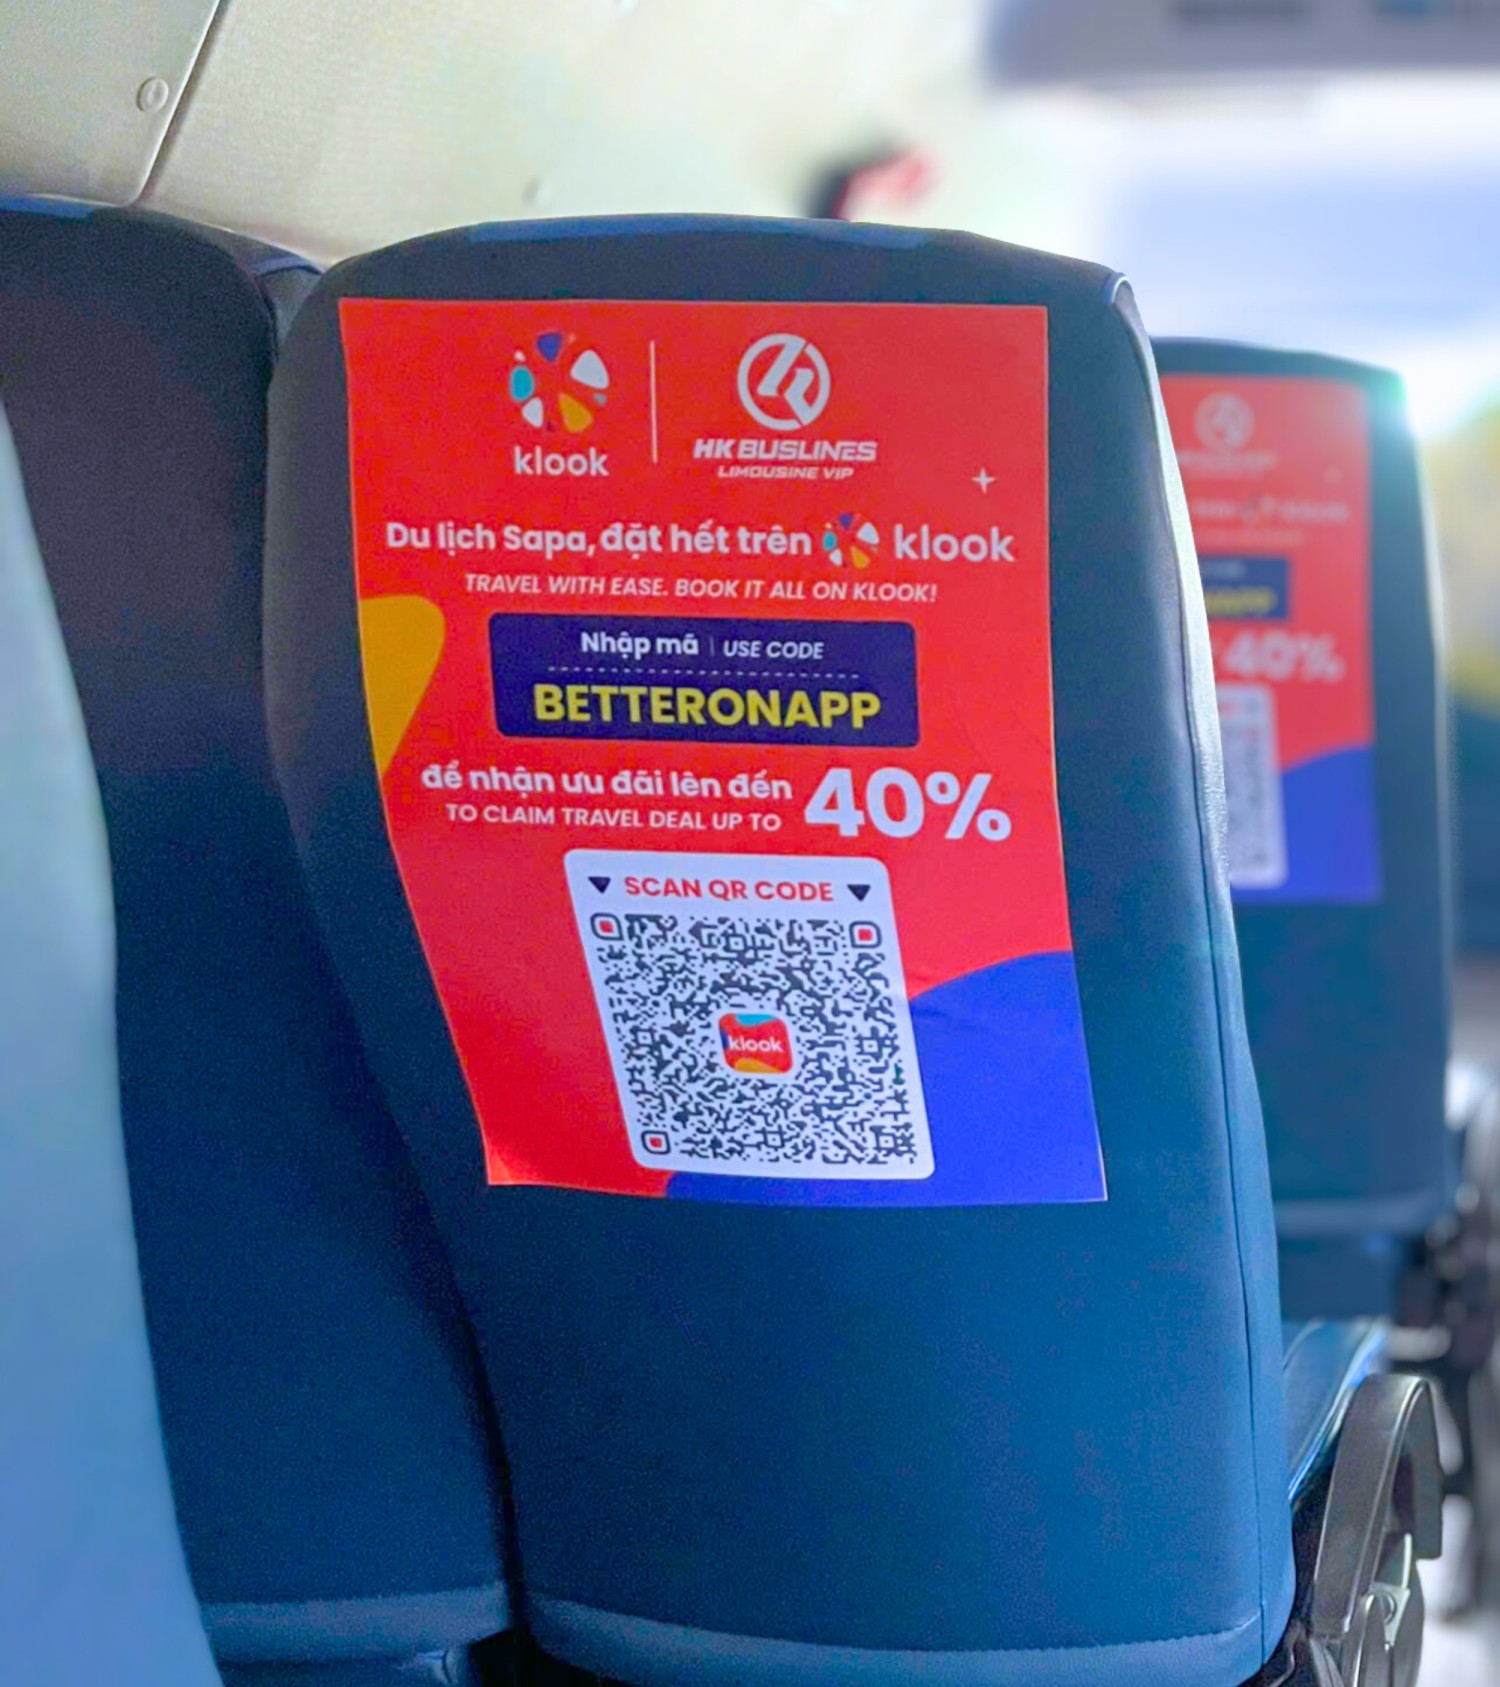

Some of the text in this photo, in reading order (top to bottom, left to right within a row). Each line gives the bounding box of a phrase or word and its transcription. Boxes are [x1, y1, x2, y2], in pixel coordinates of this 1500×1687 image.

[513, 445, 609, 477] klook
[693, 438, 877, 462] HK BUSLINES
[717, 465, 854, 480] LIMOUSINE VIP
[386, 519, 1015, 562] Du lịch Sapa, đặt hết trên klook
[465, 573, 938, 602] TRAVEL WITH EASE. BOOK IT ALL ON KLOOK!
[580, 631, 825, 660] Nhập mã USE CODE
[533, 683, 882, 729] BETTERONAPP
[421, 760, 1012, 842] để nhận ưu đãi lên đến 40%
[446, 804, 782, 831] TO CLAIM TRAVEL DEAL UP TO
[624, 877, 834, 902] SCAN QR CODE
[728, 1034, 784, 1053] klook
